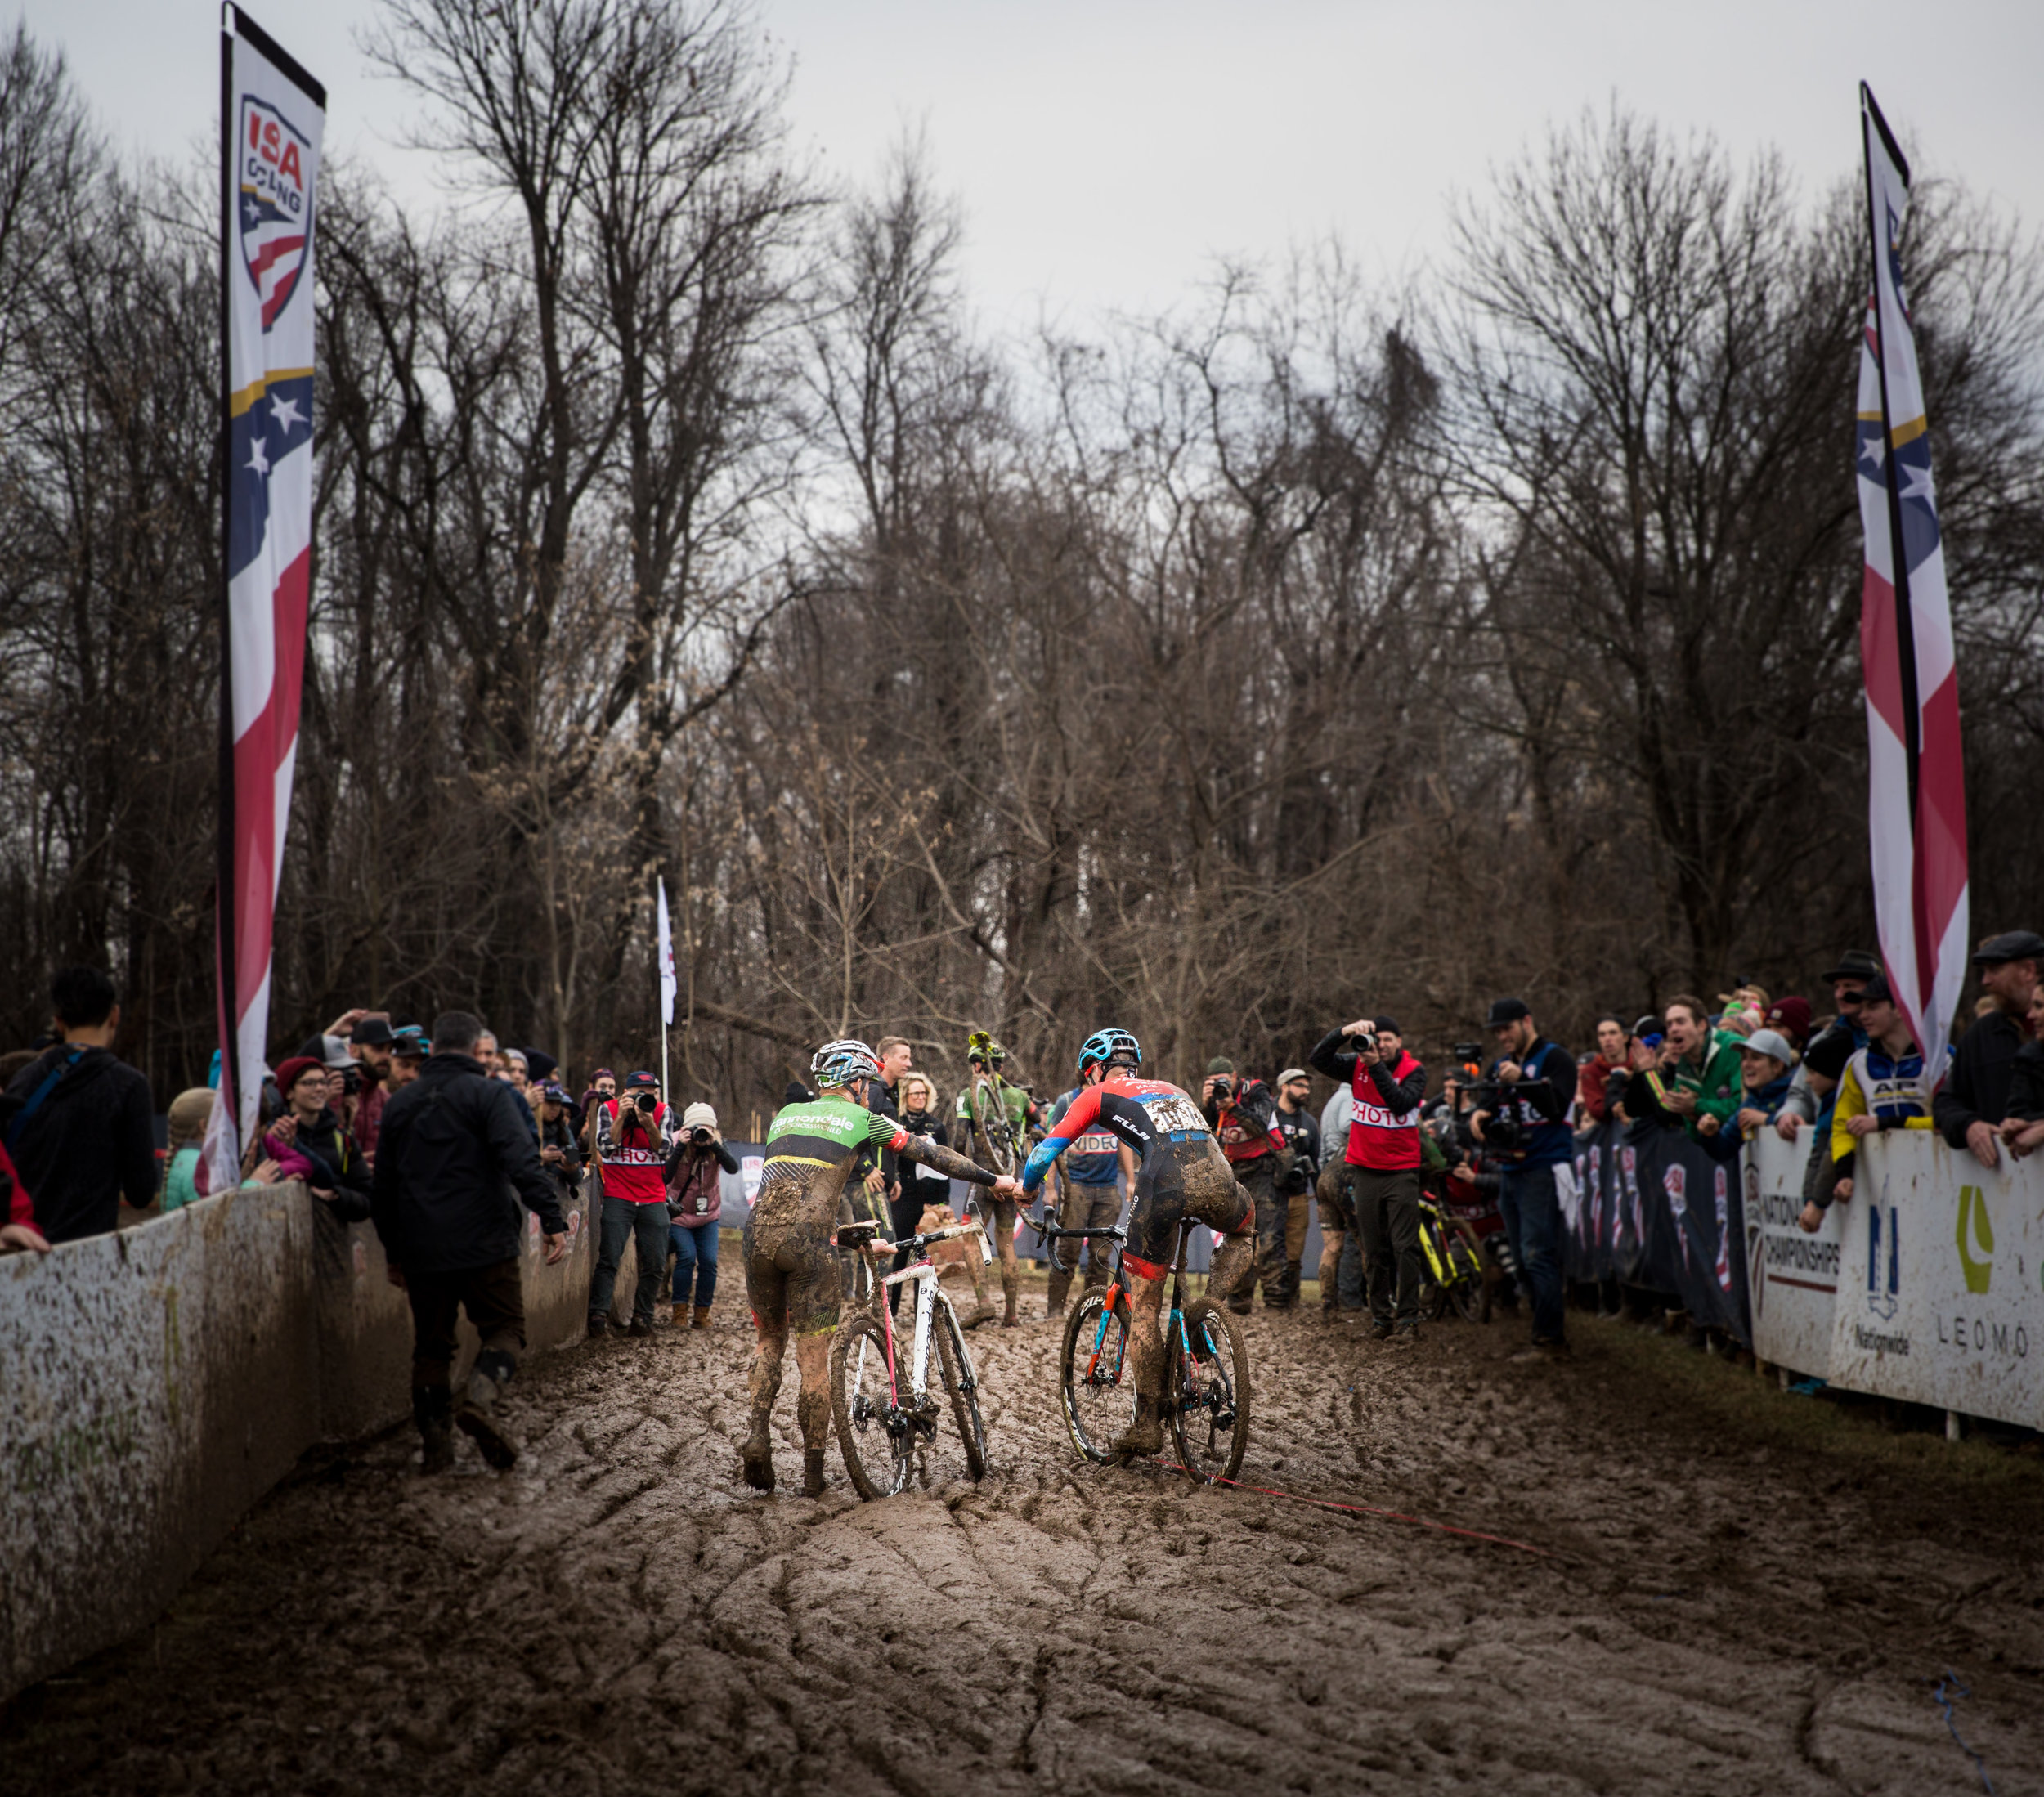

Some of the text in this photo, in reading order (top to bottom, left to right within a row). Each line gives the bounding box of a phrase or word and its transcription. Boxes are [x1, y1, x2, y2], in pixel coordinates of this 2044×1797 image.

[769, 1114, 854, 1132] cannondale
[1112, 1114, 1150, 1141] FUJI
[744, 1159, 760, 1170] US
[1765, 1233, 1840, 1276] CHAMPIONSHIPS
[1080, 1296, 1106, 1317] ZIP
[1855, 1322, 1910, 1356] Nationwide
[1937, 1314, 2028, 1358] LEOMO
